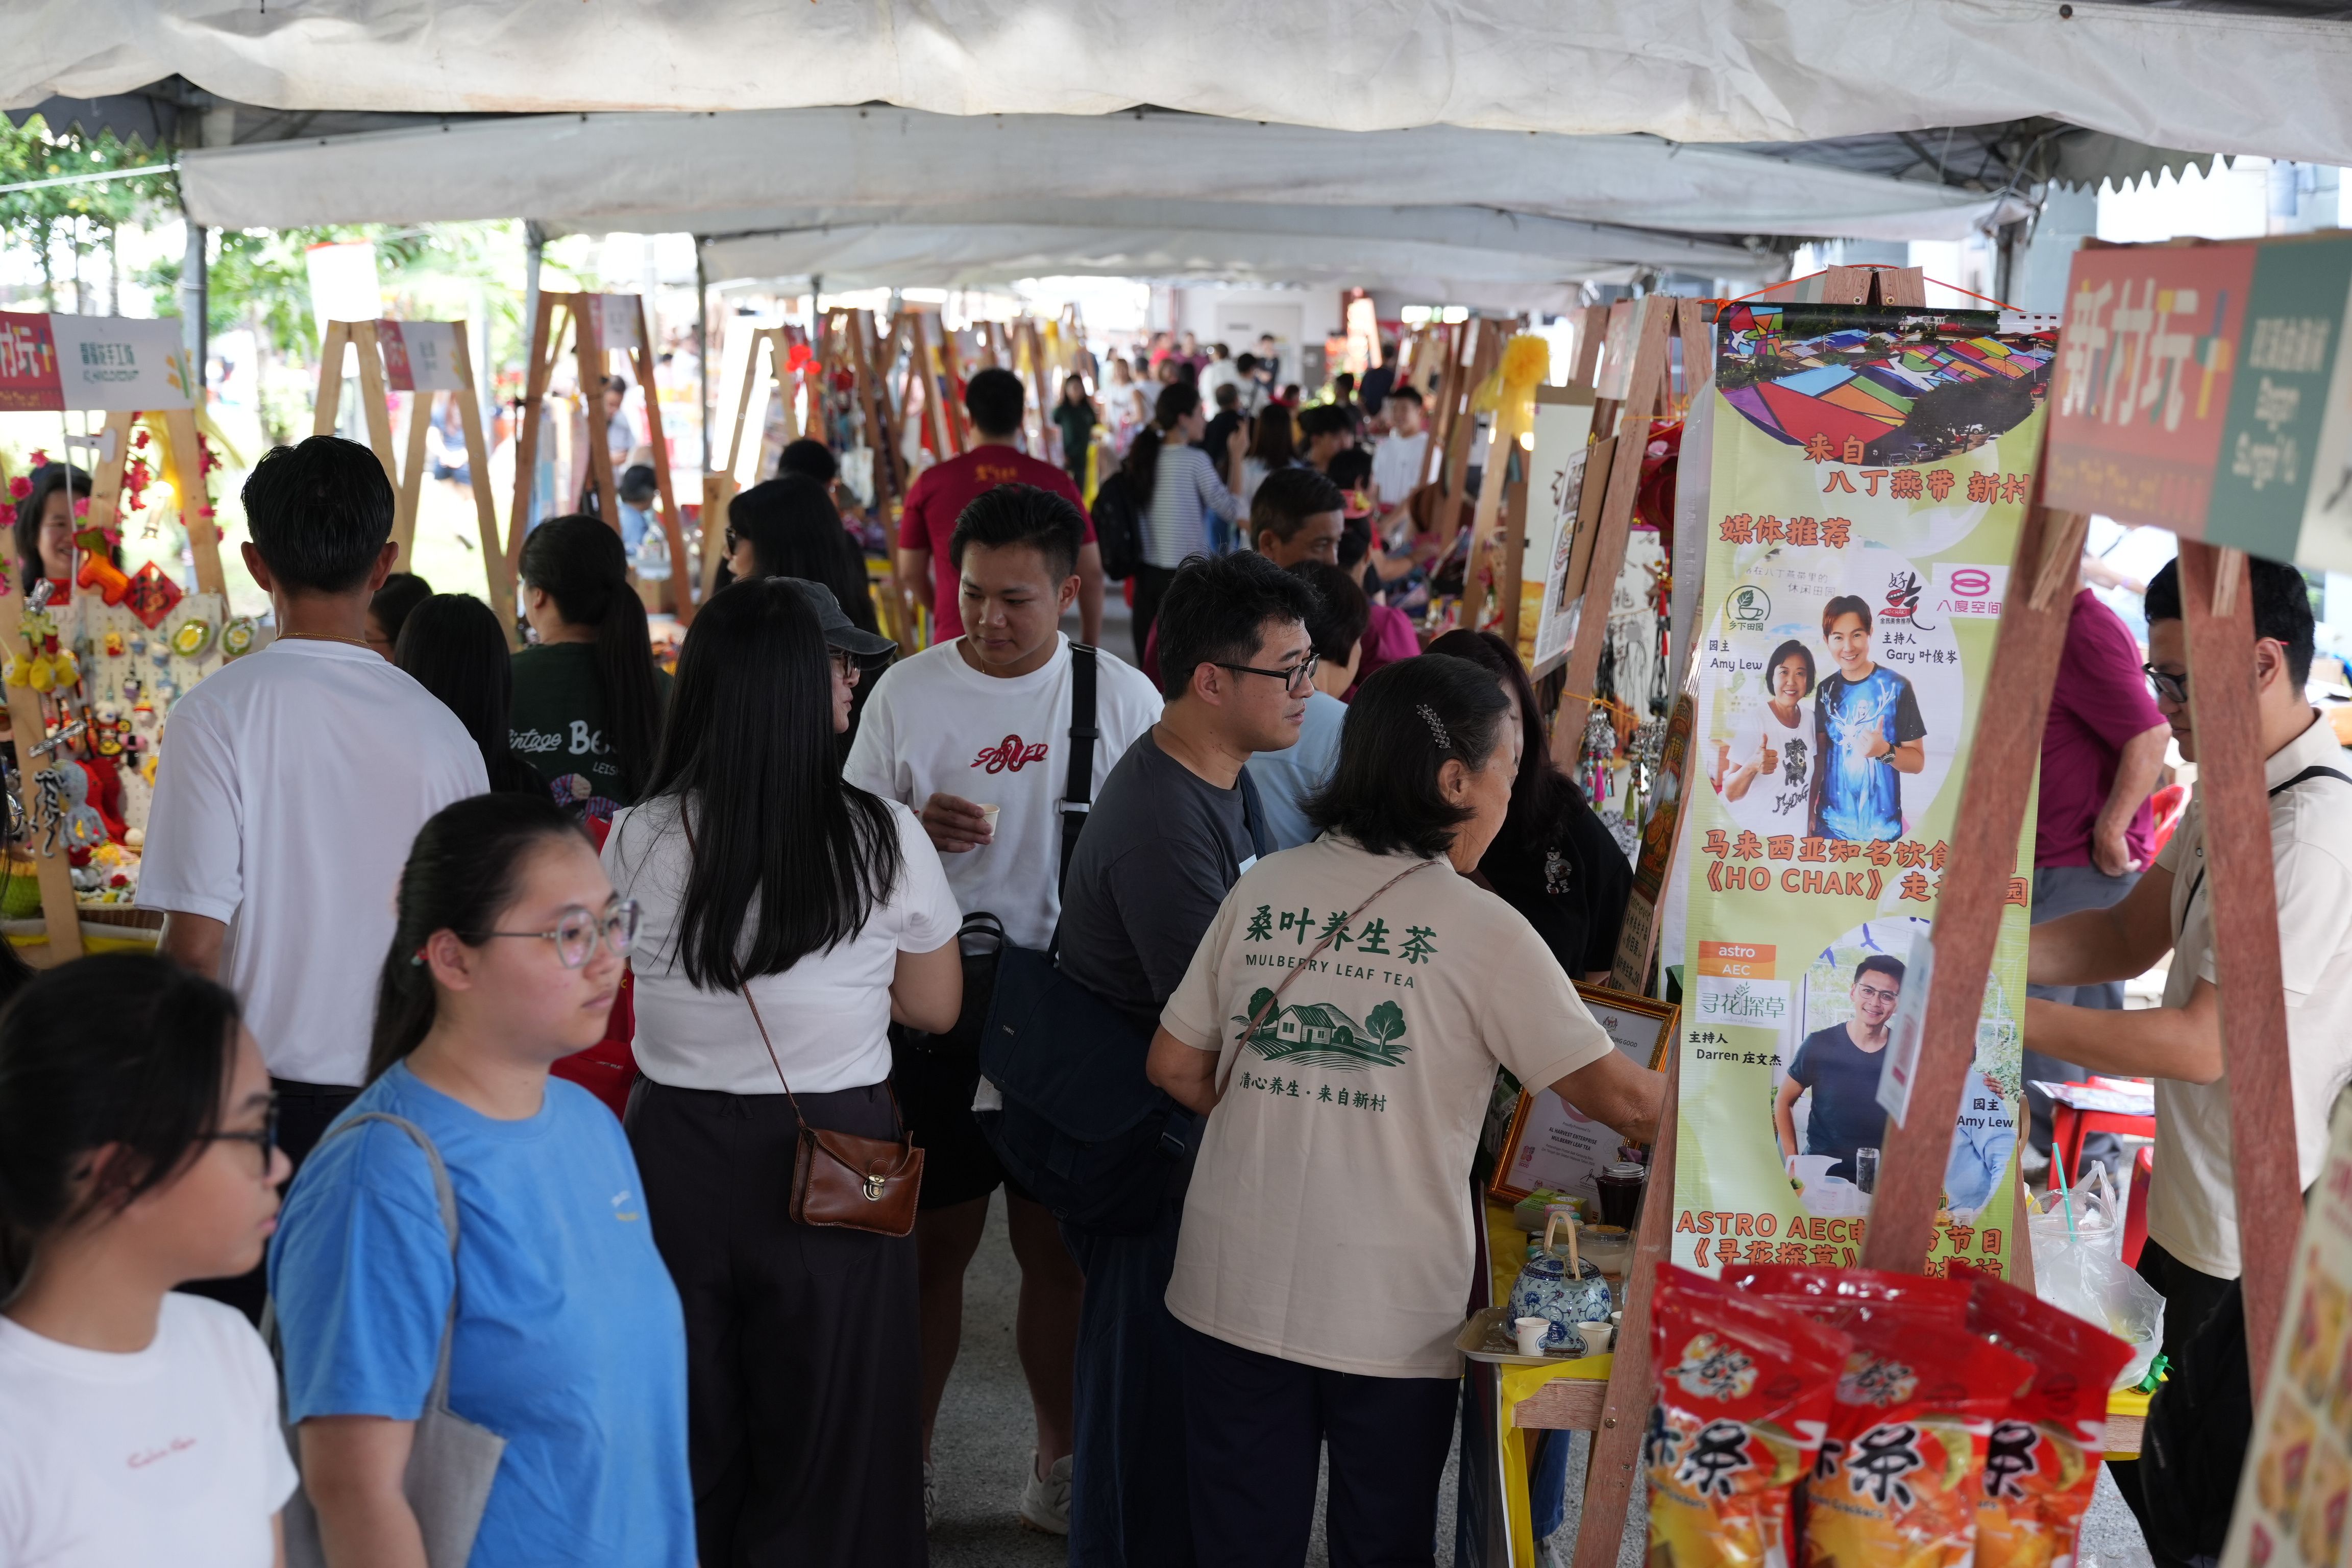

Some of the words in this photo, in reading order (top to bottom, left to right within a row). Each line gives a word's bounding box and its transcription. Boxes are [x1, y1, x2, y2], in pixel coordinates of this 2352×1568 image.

[1804, 433, 1865, 465] 来自
[1823, 469, 1955, 502] 八丁燕带
[1967, 471, 2030, 505] 新村
[1720, 513, 1851, 549] 媒体推荐
[1788, 583, 1835, 597] 休闲田园
[1937, 600, 2002, 614] 八度空间
[1729, 621, 1763, 631] 乡下田园
[1882, 632, 1917, 645] 主持人
[1709, 640, 1729, 652] 园主
[1886, 649, 1915, 664] Gary
[1919, 649, 1957, 664] 叶俊岑
[1710, 658, 1735, 672] Amy
[1739, 659, 1762, 670] Lew
[1702, 829, 1950, 872] 马来西亚知名饮食
[1243, 904, 1438, 964] 桑叶养生茶
[1719, 945, 1755, 958] astro
[1245, 953, 1329, 973] MULBERRY
[1336, 963, 1375, 981] LEAF
[1383, 971, 1414, 989] TEA
[1722, 964, 1750, 976] AEC
[1700, 992, 1786, 1018] 寻花探草
[1623, 1039, 1637, 1047] GOOD
[1688, 1031, 1728, 1044] 主持人
[1697, 1048, 1738, 1061] Darren
[1742, 1051, 1781, 1066] 庄文杰
[1972, 1097, 1999, 1111] 园主
[1956, 1115, 1984, 1129] Amy
[1988, 1116, 2014, 1128] Lew
[1551, 1135, 1573, 1145] MULBERRY
[1554, 1129, 1573, 1137] HARVEST
[1573, 1134, 1597, 1145] ENTERPRISE
[1676, 1211, 1777, 1237] ASTRO
